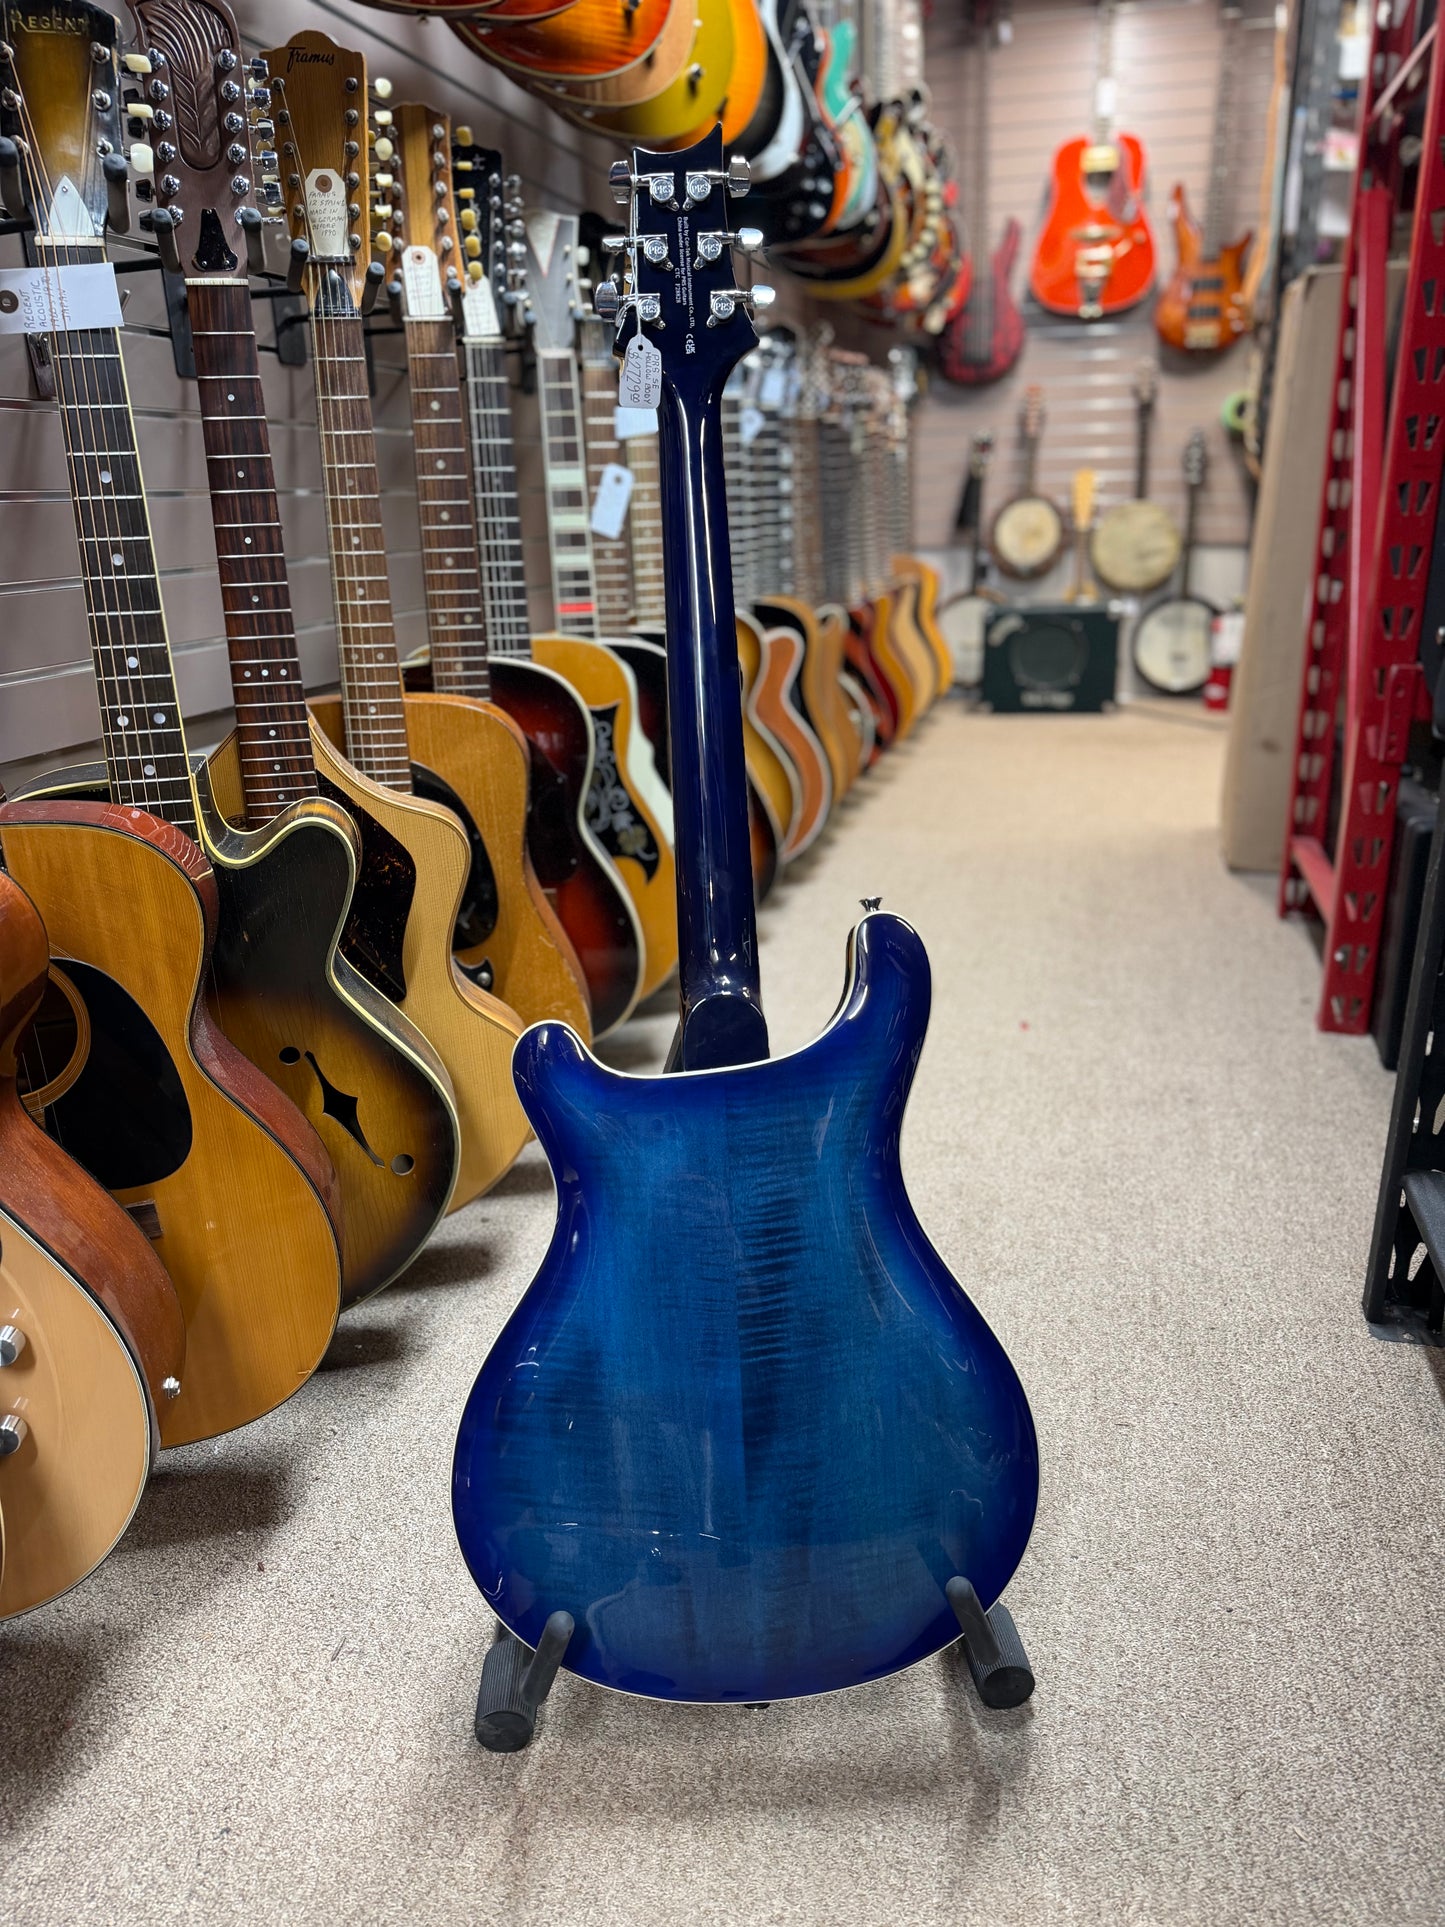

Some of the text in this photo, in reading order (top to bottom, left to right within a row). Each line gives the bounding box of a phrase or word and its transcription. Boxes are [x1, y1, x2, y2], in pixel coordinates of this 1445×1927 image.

[287, 46, 335, 73] Framus
[654, 184, 671, 195] PRS
[691, 183, 709, 194] PRS
[648, 245, 666, 255] PRS
[702, 243, 719, 254] PRS
[19, 288, 36, 329] REGENT
[30, 280, 47, 328] ACOUSTIC
[640, 304, 657, 314] PRS
[715, 302, 733, 312] PRS
[651, 353, 660, 389] PRS SE
[643, 383, 652, 405] BODY
